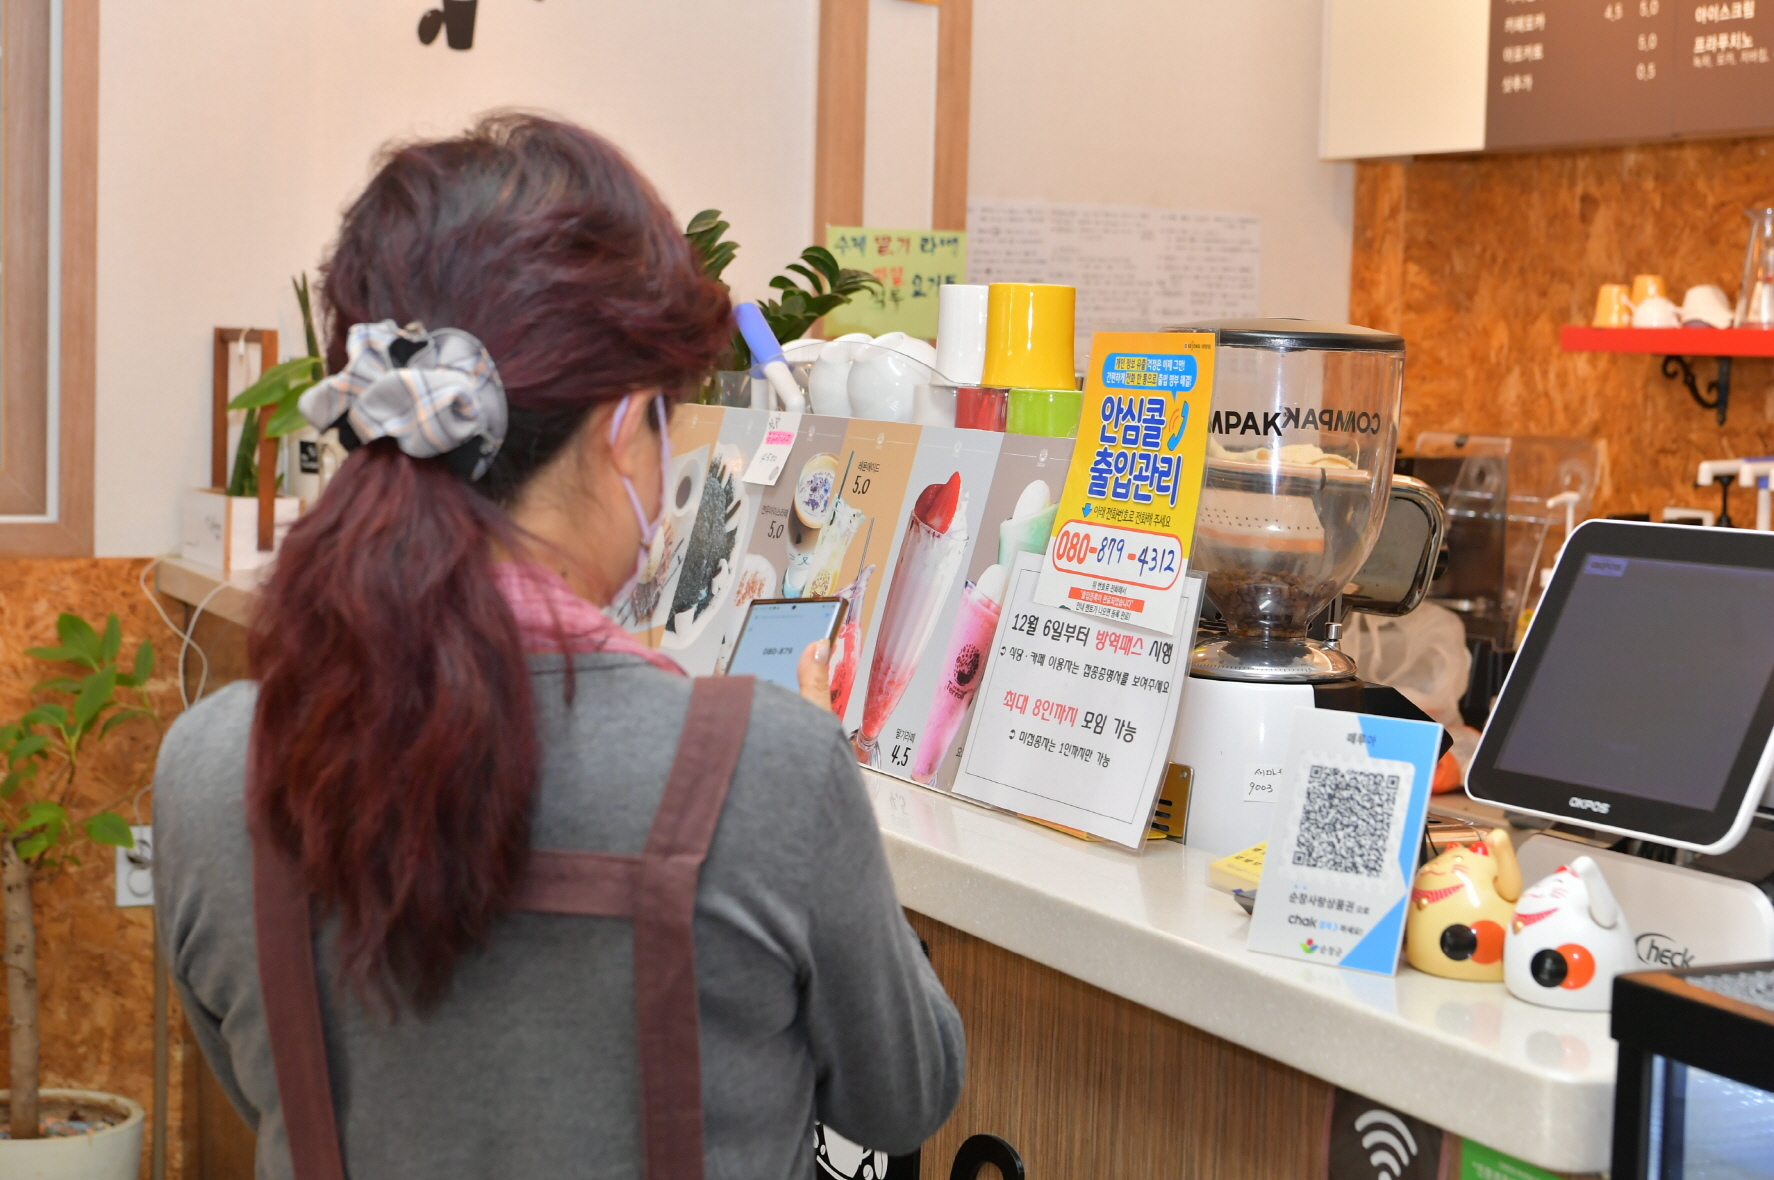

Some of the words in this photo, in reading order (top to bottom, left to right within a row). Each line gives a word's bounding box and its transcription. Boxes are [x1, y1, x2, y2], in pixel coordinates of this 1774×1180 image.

[1695, 0, 1755, 24] 아이스크림
[1637, 32, 1658, 51] 5.0
[1115, 357, 1125, 370] 개인
[1126, 358, 1135, 370] 정보
[1136, 358, 1146, 371] 유출
[1147, 359, 1162, 371] 걱정은
[1163, 359, 1173, 371] 이제
[1106, 371, 1125, 384] 간편하게
[1126, 373, 1136, 385] 전화
[1143, 374, 1157, 386] 통으로
[1158, 374, 1168, 387] 출입
[1169, 374, 1179, 387] 명부
[1100, 394, 1166, 450] 안심콜
[858, 461, 880, 473] 레몬에이드
[1087, 446, 1182, 507] 출입관리
[852, 475, 871, 495] 5.0
[1094, 506, 1106, 518] 아래
[1106, 507, 1134, 522] 전화번호로
[1135, 511, 1153, 526] 전화해
[1153, 514, 1171, 528] 주세요
[768, 520, 784, 539] 5.0
[1076, 601, 1085, 612] 안내
[1085, 604, 1098, 614] 멘트가
[1098, 606, 1111, 617] 나오면
[1111, 609, 1120, 619] 등록
[1011, 613, 1039, 636] 12월
[1043, 619, 1090, 647] 6일부터
[1095, 630, 1144, 656] 방역패스
[1149, 640, 1174, 665] 시행
[762, 647, 793, 655] 080-879
[1009, 646, 1024, 662] 식당
[1031, 652, 1046, 666] 카페
[1049, 656, 1080, 675] 이용자는
[1083, 664, 1129, 686] 접종증명서를
[1131, 676, 1170, 694] 보여주세요
[1003, 690, 1029, 715] 최대
[1032, 699, 1079, 728] 8인까지
[1081, 711, 1107, 735] 모임
[1114, 717, 1137, 743] 가능
[891, 744, 912, 767] 4.5
[1018, 731, 1056, 753] 미접종자는
[1058, 742, 1093, 763] 1인까지만
[1097, 751, 1111, 768] 가능
[1248, 781, 1273, 795] 9003
[1568, 796, 1611, 814] OKPOS
[1288, 914, 1317, 928] chak
[1635, 933, 1695, 969] Check
